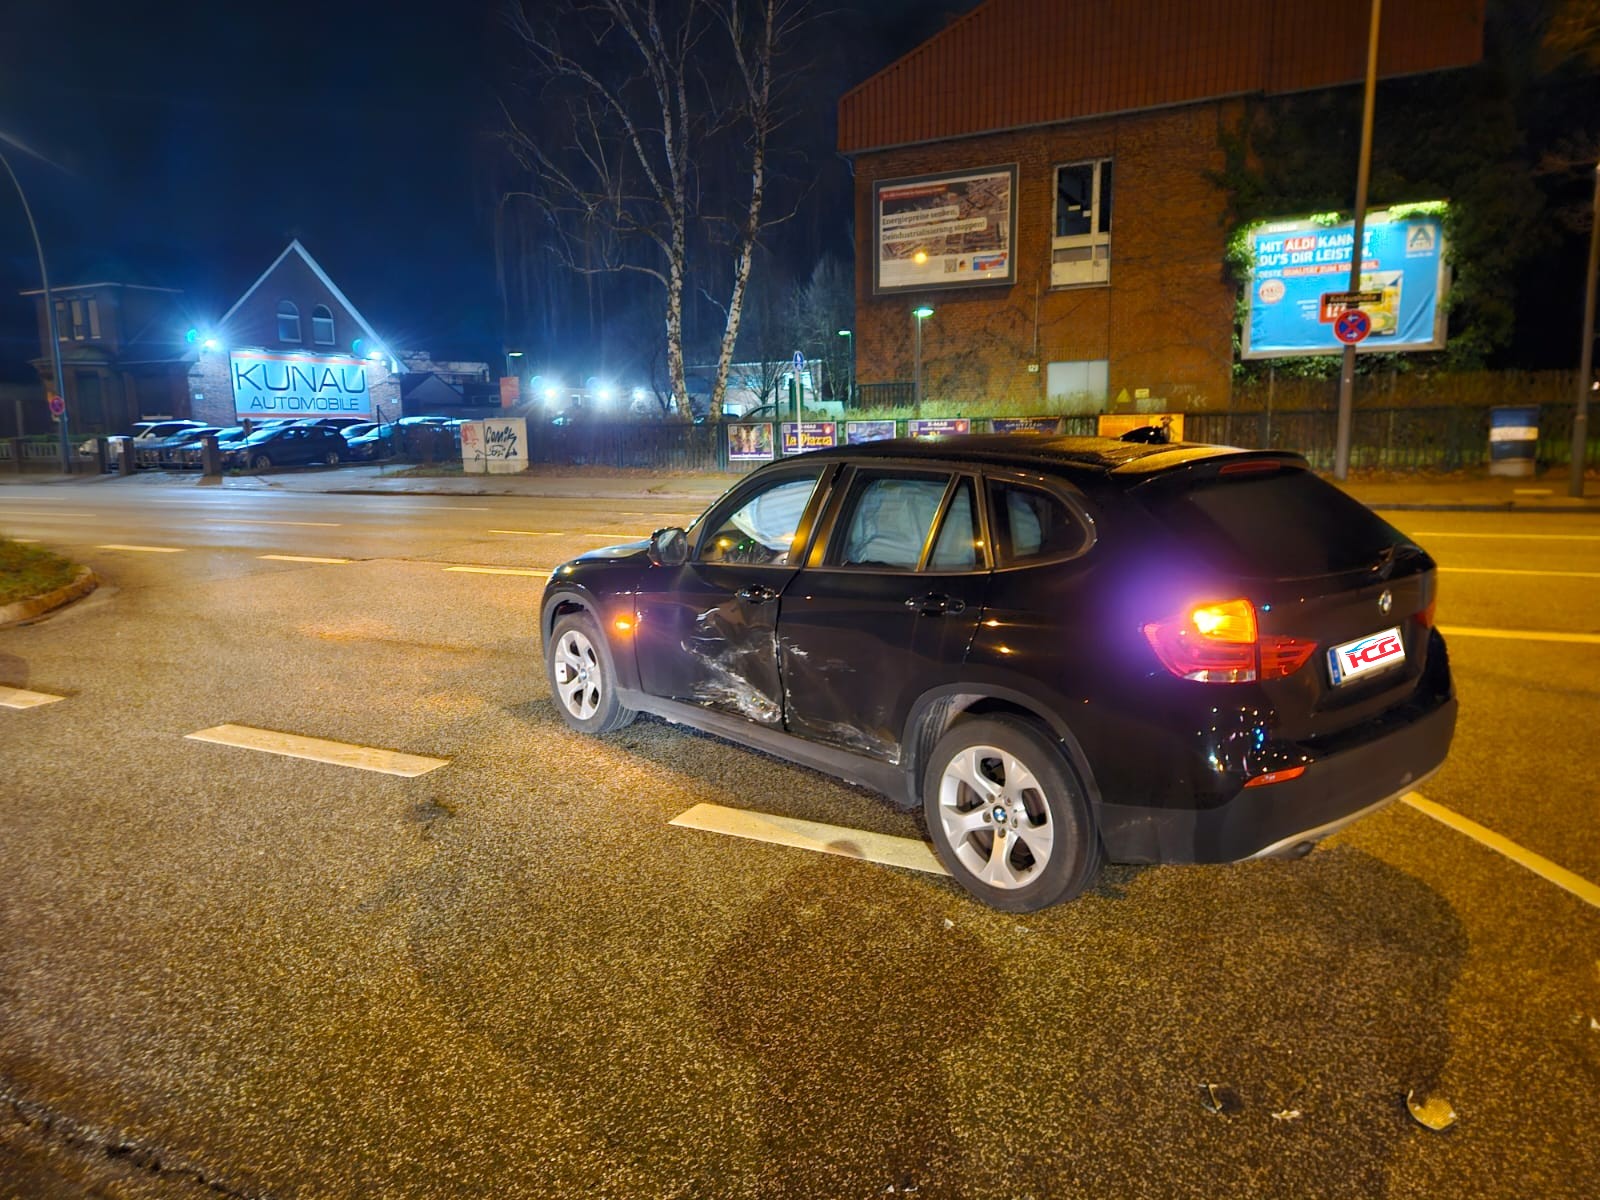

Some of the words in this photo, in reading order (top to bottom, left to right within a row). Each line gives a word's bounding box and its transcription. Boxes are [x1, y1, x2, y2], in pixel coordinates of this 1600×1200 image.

[881, 213, 930, 226] Energiepreise
[881, 224, 953, 241] Deindustrialisierung
[1260, 240, 1283, 253] MIT
[1285, 237, 1315, 252] ALDI
[1317, 231, 1373, 248] KANNT
[1291, 249, 1314, 264] DIR
[1316, 246, 1372, 261] LEISTN.
[234, 362, 366, 394] KUNAU
[250, 395, 360, 411] AUTOMOBILE
[800, 433, 833, 447] Piazza
